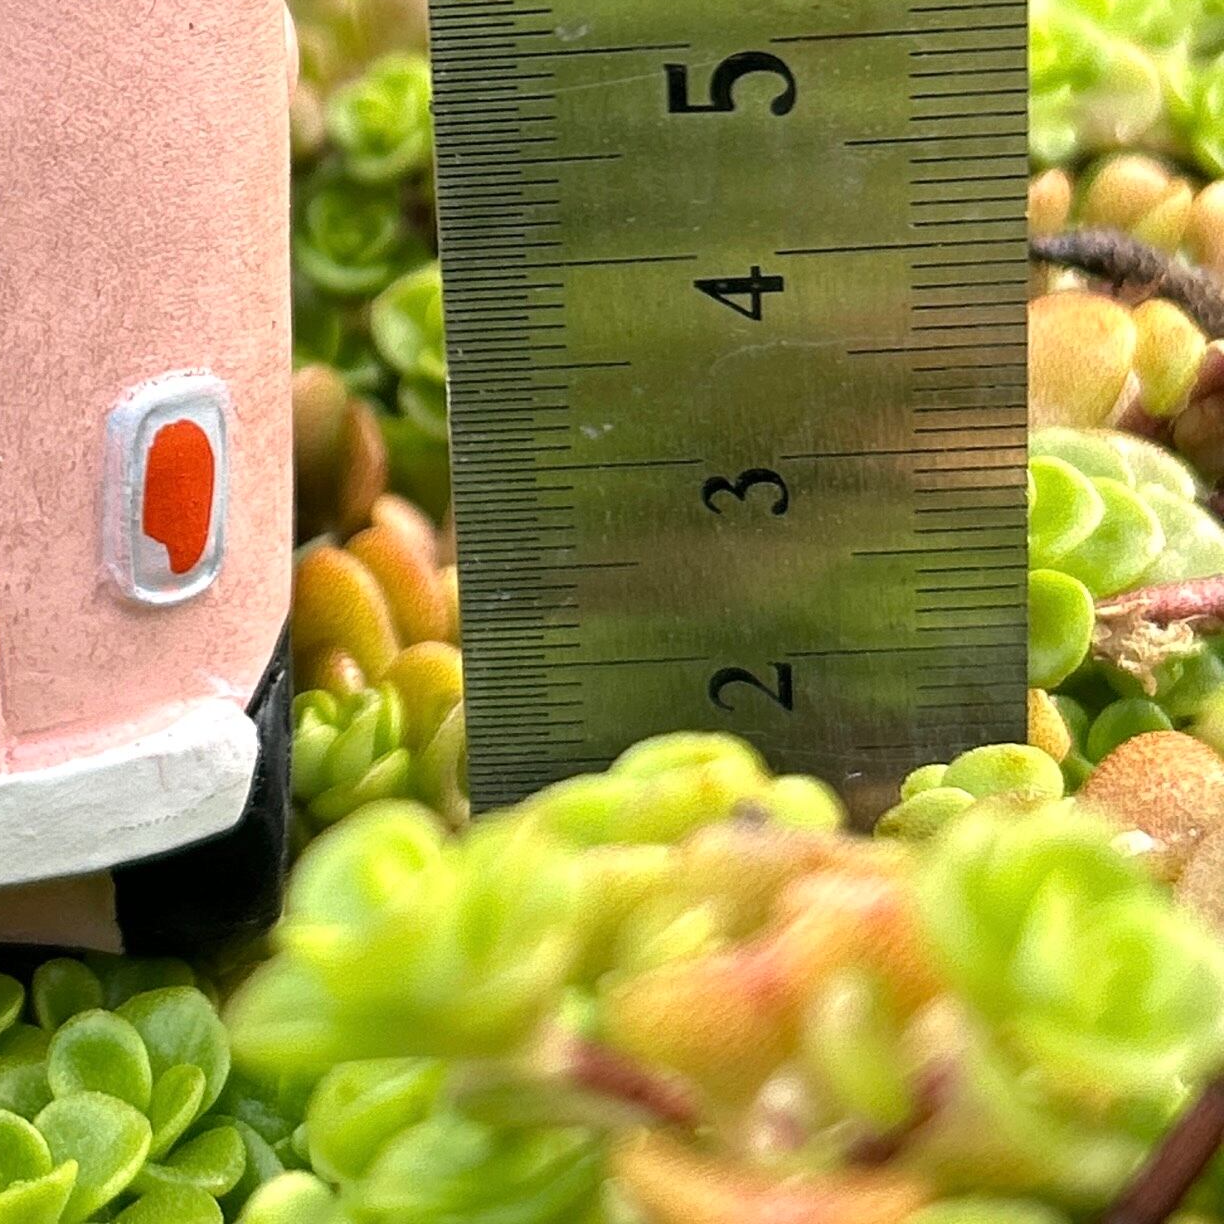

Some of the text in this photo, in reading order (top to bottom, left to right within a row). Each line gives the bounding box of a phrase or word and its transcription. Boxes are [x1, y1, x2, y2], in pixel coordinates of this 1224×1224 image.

[664, 50, 797, 117] 5
[693, 265, 784, 321] 4
[701, 467, 790, 516] 3
[708, 661, 794, 713] 2
